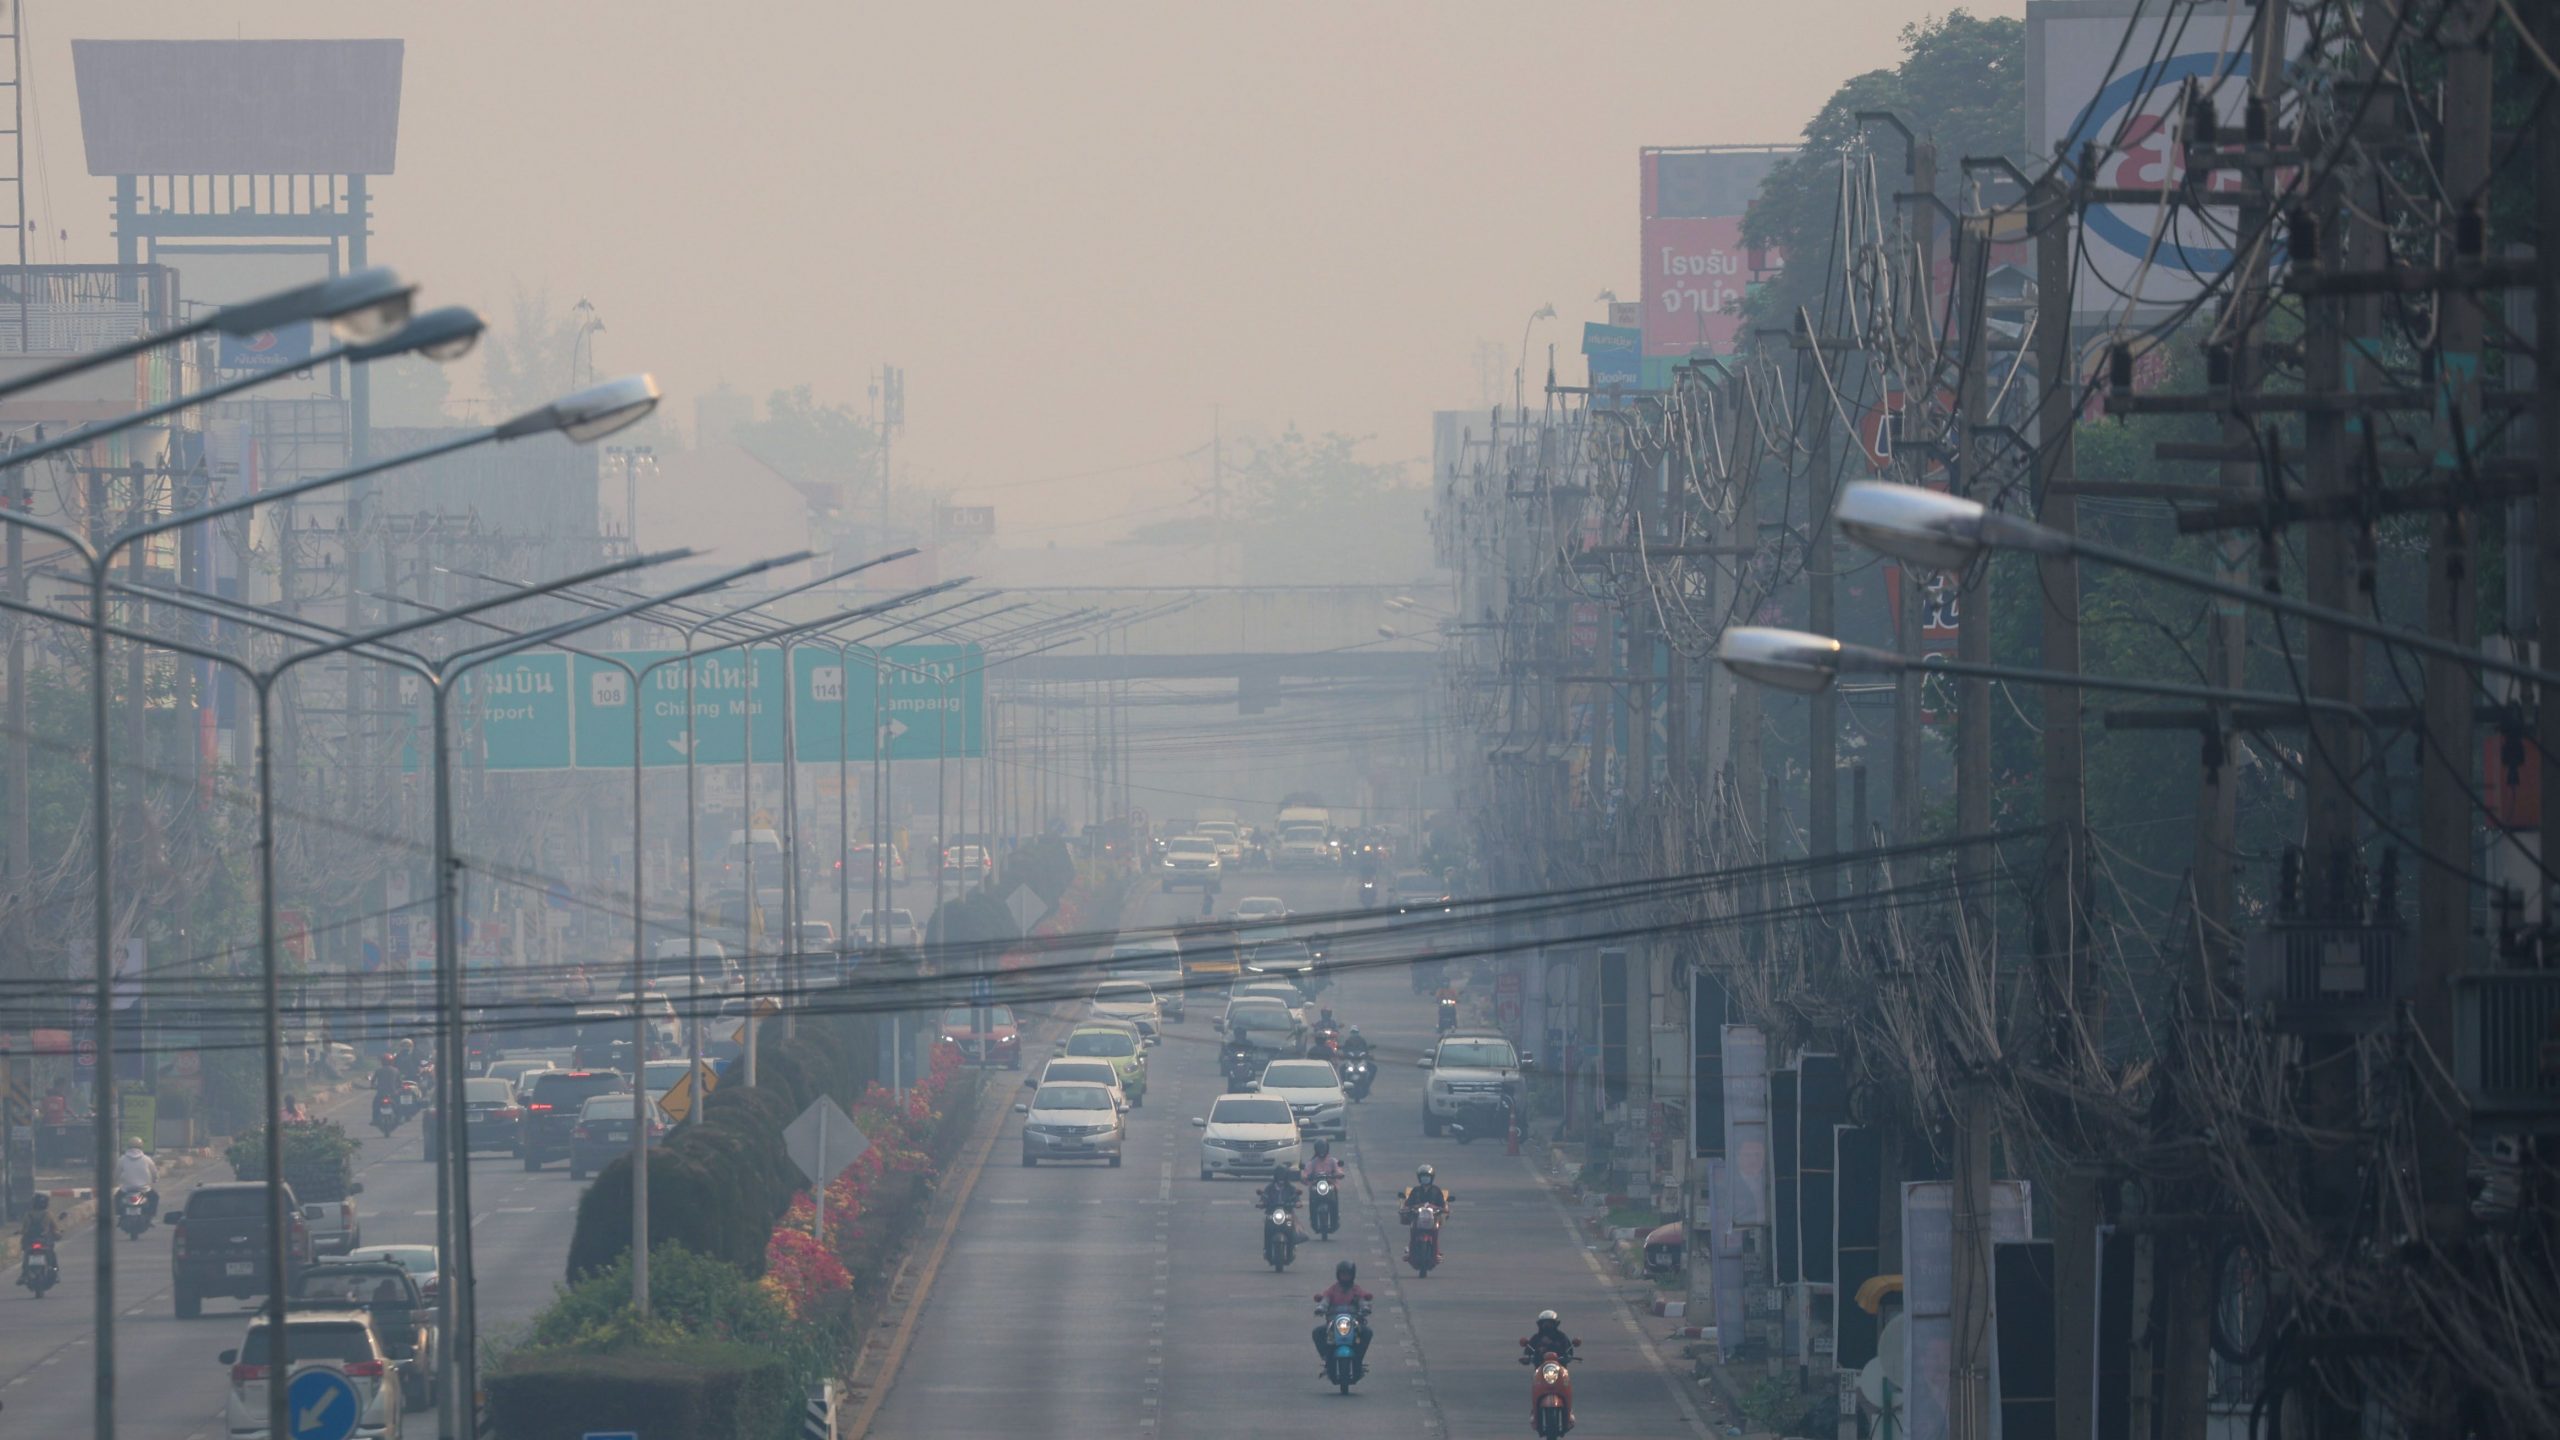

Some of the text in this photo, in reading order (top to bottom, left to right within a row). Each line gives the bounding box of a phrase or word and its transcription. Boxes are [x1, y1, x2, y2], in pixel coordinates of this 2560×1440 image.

[1661, 247, 1738, 276] โรงรับ
[1661, 280, 1739, 314] จำนำ
[597, 689, 621, 702] 108
[483, 703, 535, 723] rport
